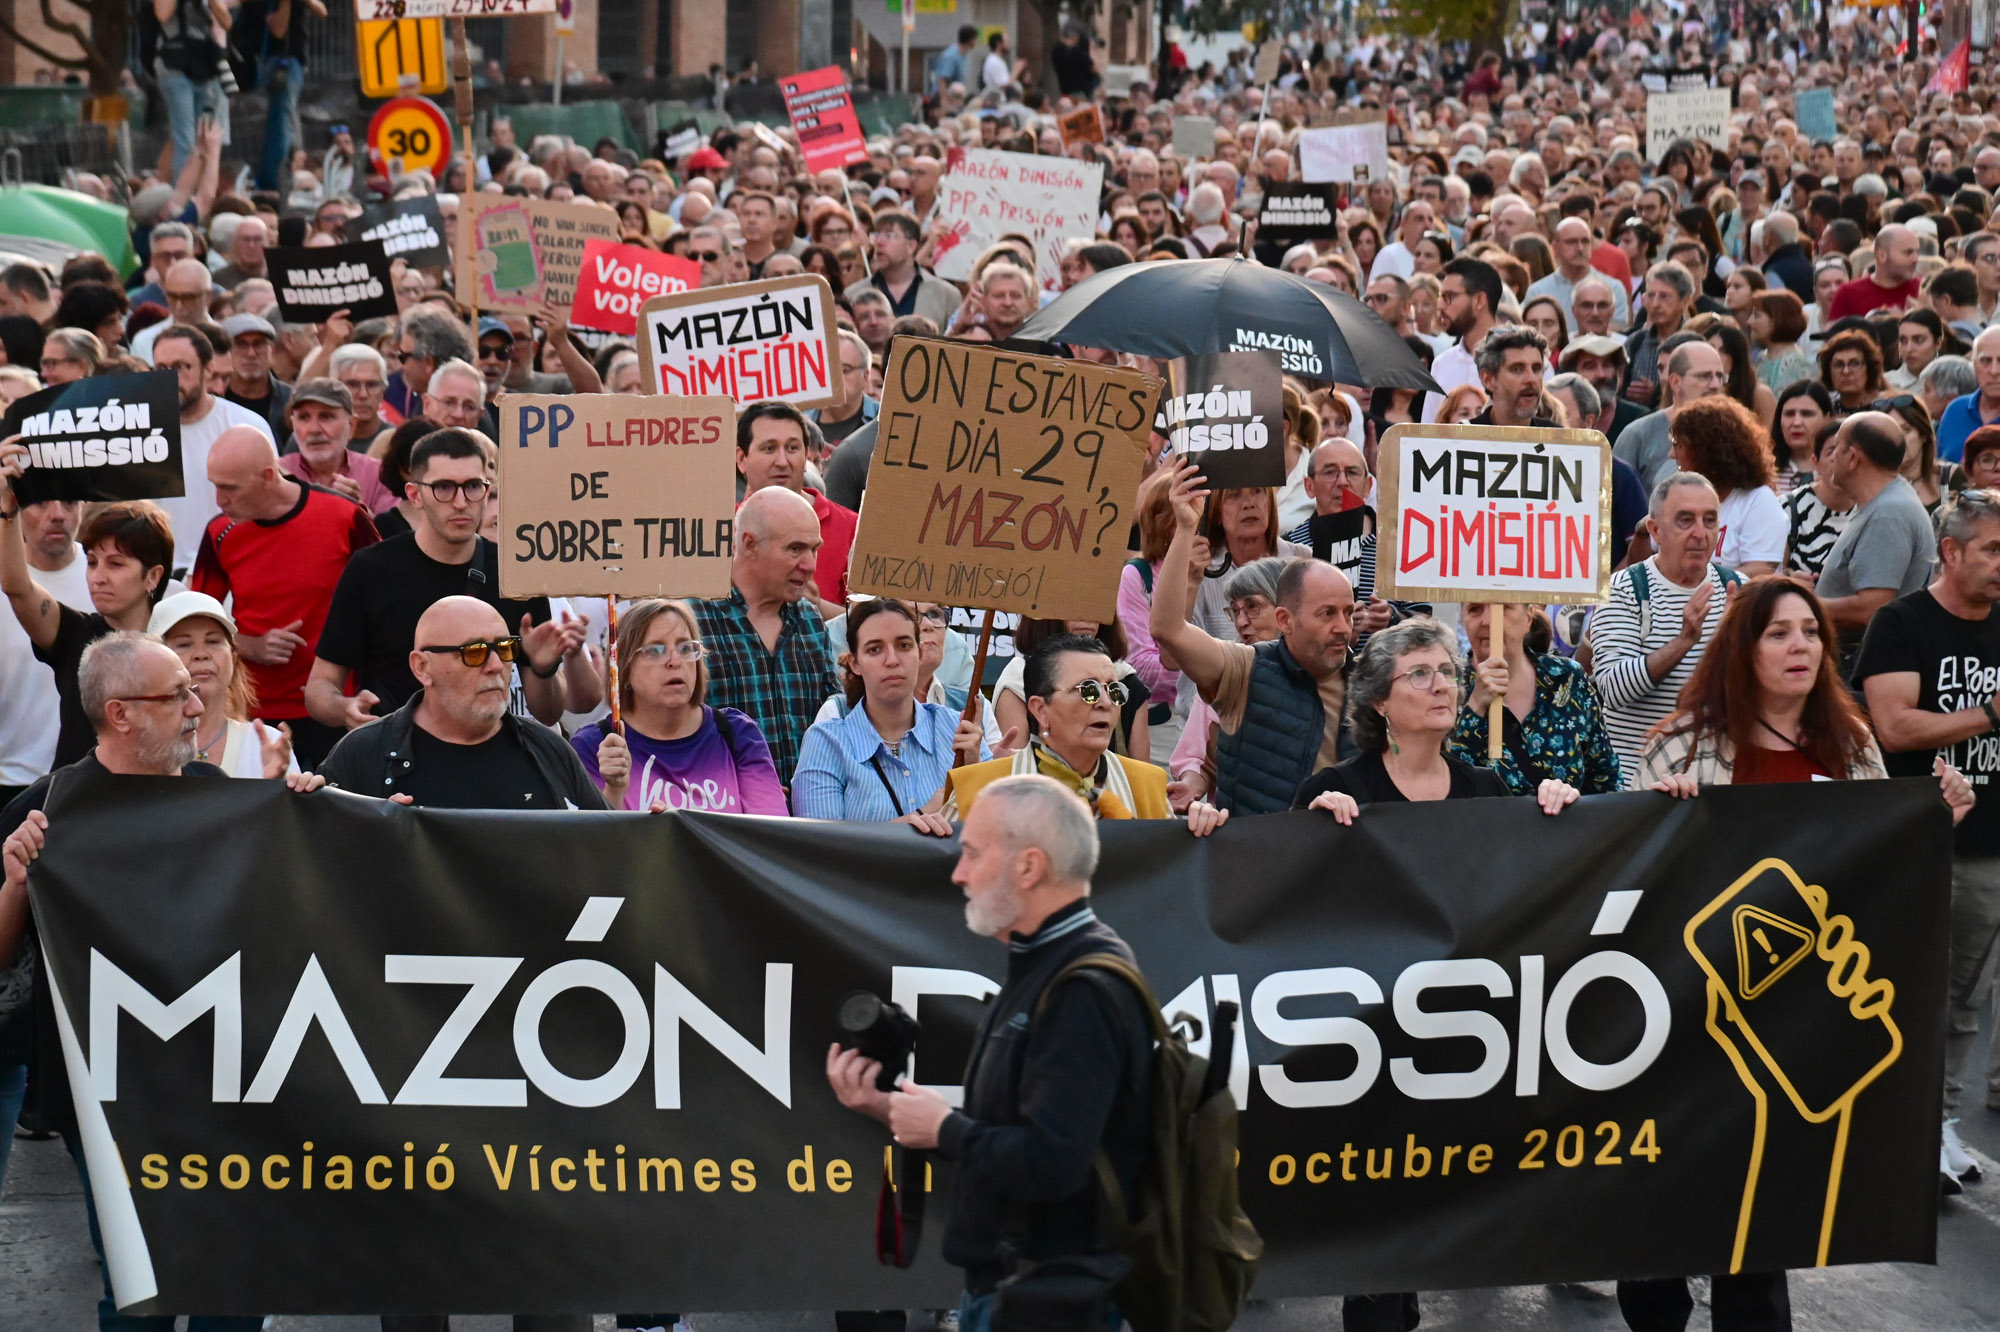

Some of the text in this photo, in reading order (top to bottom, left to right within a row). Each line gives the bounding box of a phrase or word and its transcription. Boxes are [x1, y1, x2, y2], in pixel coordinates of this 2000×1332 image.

[388, 128, 431, 156] 30
[950, 189, 977, 216] PP
[979, 204, 989, 216] A
[1260, 208, 1331, 225] DIMISSIÓ
[1268, 194, 1324, 211] MAZÓN
[533, 216, 549, 229] NO
[383, 227, 440, 257] ISSIÓ
[287, 261, 370, 287] MAZÓN
[541, 250, 582, 267] PERQU
[282, 277, 384, 305] DIMISSIÓ
[543, 270, 577, 285] HAVIE
[595, 255, 687, 295] Volem
[594, 288, 643, 317] vot
[656, 292, 814, 354] MAZÓN
[1236, 328, 1313, 355] MAZÓN
[900, 344, 1147, 432] ON ESTAVES
[21, 398, 150, 437] MAZÓN
[519, 404, 722, 448] PP LLADRES
[883, 411, 929, 470] EL
[1170, 415, 1269, 456] MISSIÓ
[570, 471, 609, 501] DE
[1412, 443, 1583, 503] MAZÓN
[515, 518, 733, 562] SOBRE TAULA
[860, 553, 934, 592] MAZÓN
[1937, 656, 1963, 691] EL
[90, 889, 1671, 1111] MAZÓN DISSIÓ
[114, 1140, 455, 1190] ssociació
[483, 1141, 758, 1194] Víctimes
[787, 1144, 852, 1193] de
[1268, 1134, 1493, 1185] octubre
[1519, 1119, 1662, 1170] 2024
